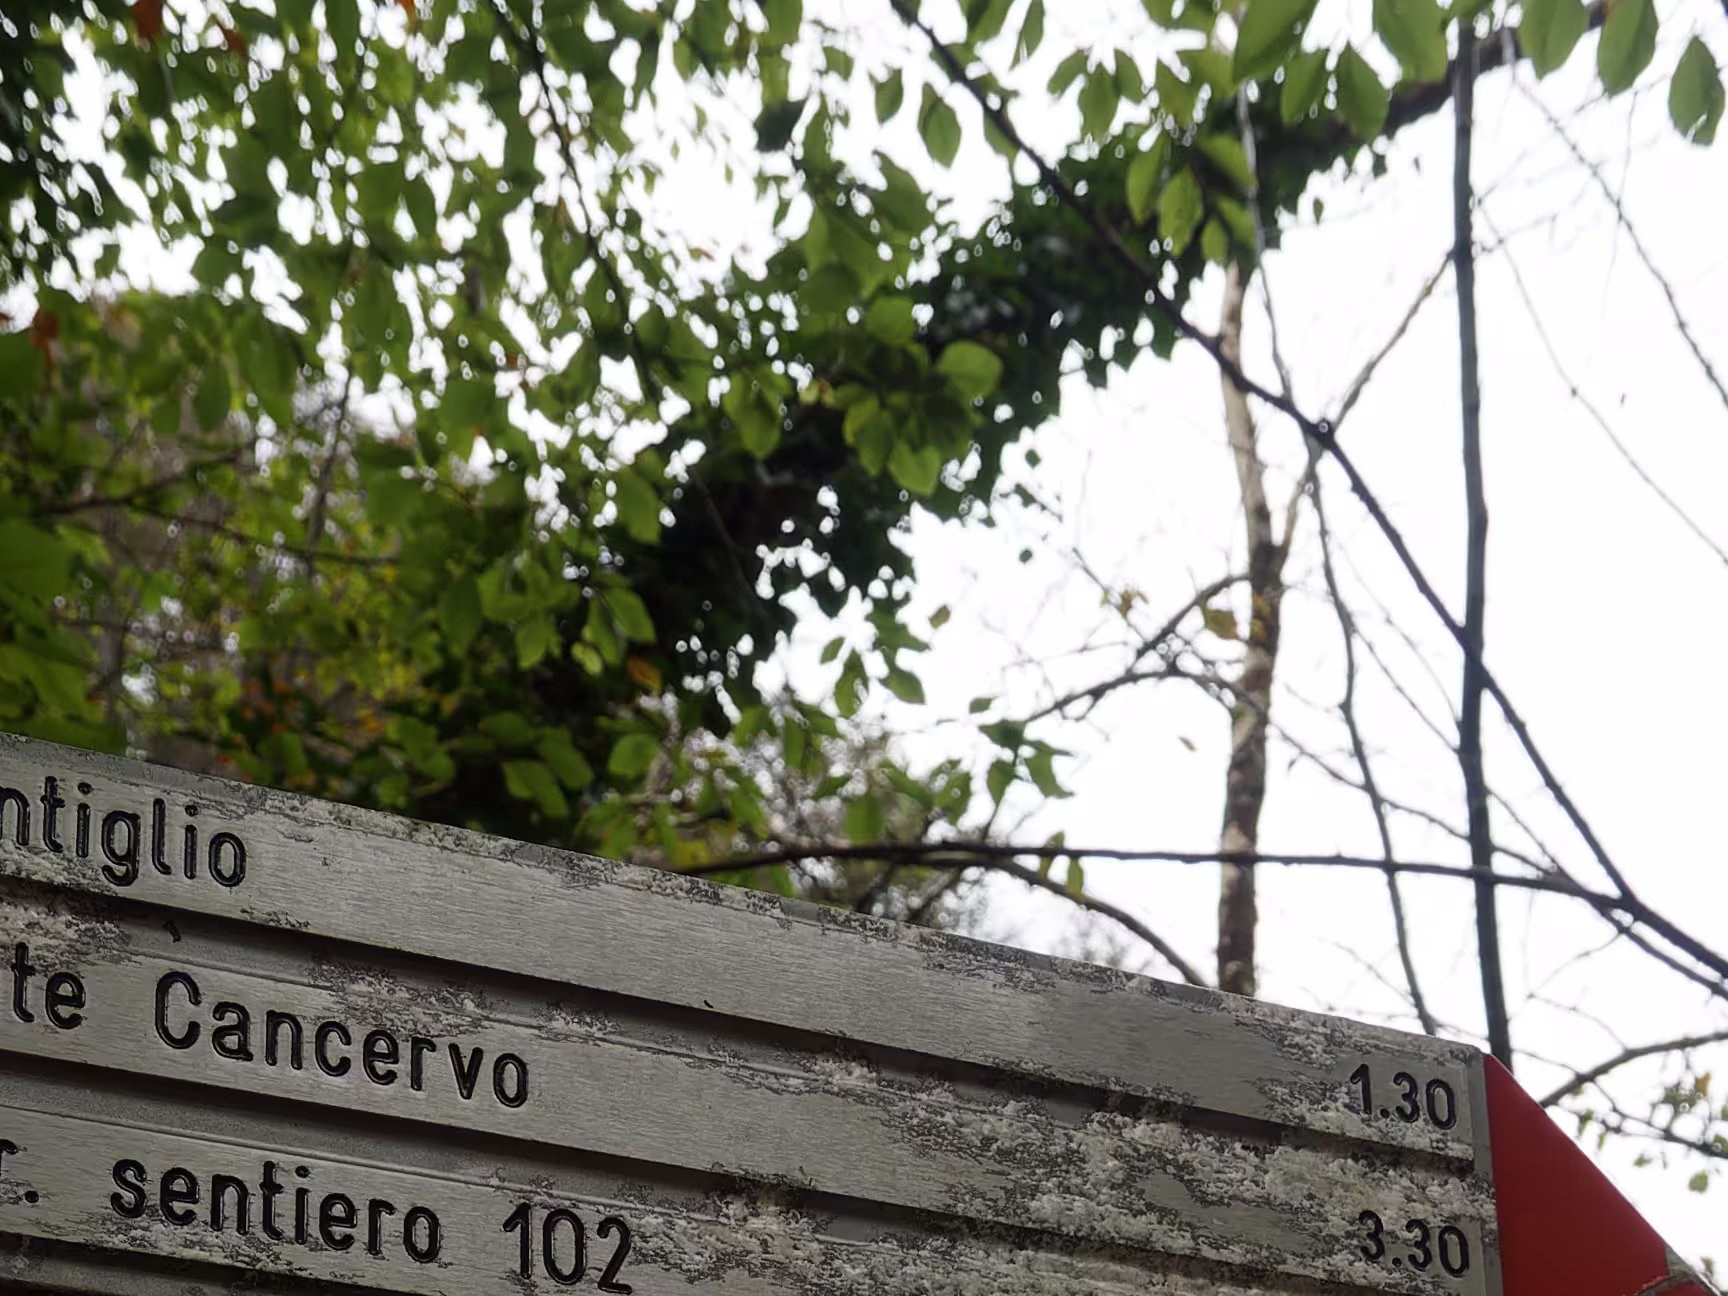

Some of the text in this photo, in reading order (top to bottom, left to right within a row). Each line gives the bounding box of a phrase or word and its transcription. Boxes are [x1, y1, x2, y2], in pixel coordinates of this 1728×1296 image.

[155, 971, 530, 1110] Cancervo
[1350, 1063, 1457, 1130] 1.30
[109, 1156, 441, 1266] sentiero
[503, 1203, 633, 1296] 102
[1358, 1209, 1470, 1278] 3.30
